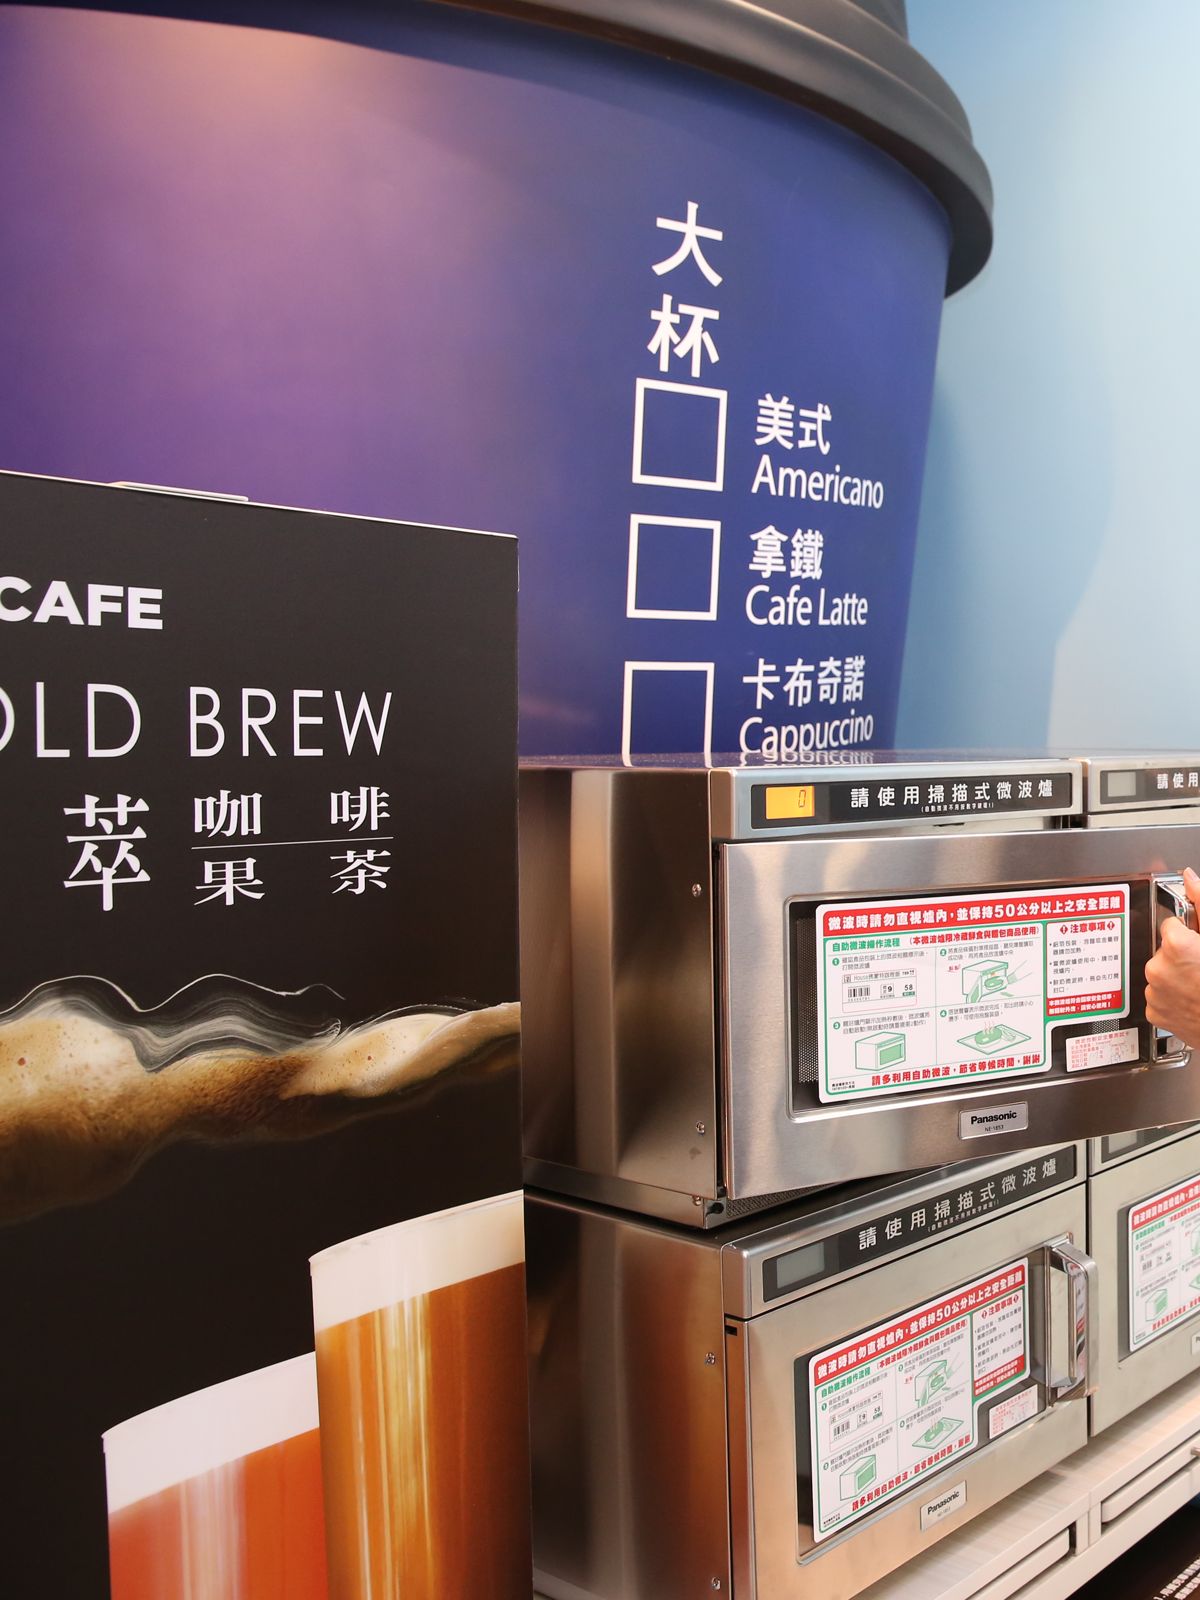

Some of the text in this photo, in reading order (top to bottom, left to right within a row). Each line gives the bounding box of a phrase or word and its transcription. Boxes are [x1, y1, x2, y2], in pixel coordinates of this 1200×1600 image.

[648, 201, 723, 378] 大杯
[754, 393, 832, 455] 美式
[751, 453, 884, 509] Americano
[748, 524, 824, 581] 拿鐵
[0, 576, 163, 630] CAFE
[745, 583, 869, 627] Cafe Latte
[743, 655, 866, 710] 卡布奇諾
[190, 686, 393, 757] BREW
[739, 708, 874, 753] Cappuccino
[194, 786, 391, 838] 咖啡
[850, 779, 1053, 808] 請使用掃描式微波爐
[63, 793, 151, 912] 萃
[194, 849, 392, 906] 果茶
[832, 938, 900, 953] 自助微波操作流程
[1070, 921, 1106, 934] 注意事項
[970, 1110, 1018, 1125] Panasonic
[858, 1157, 1057, 1250] 請使用掃描式微波爐
[926, 1490, 960, 1515] Panasonic
